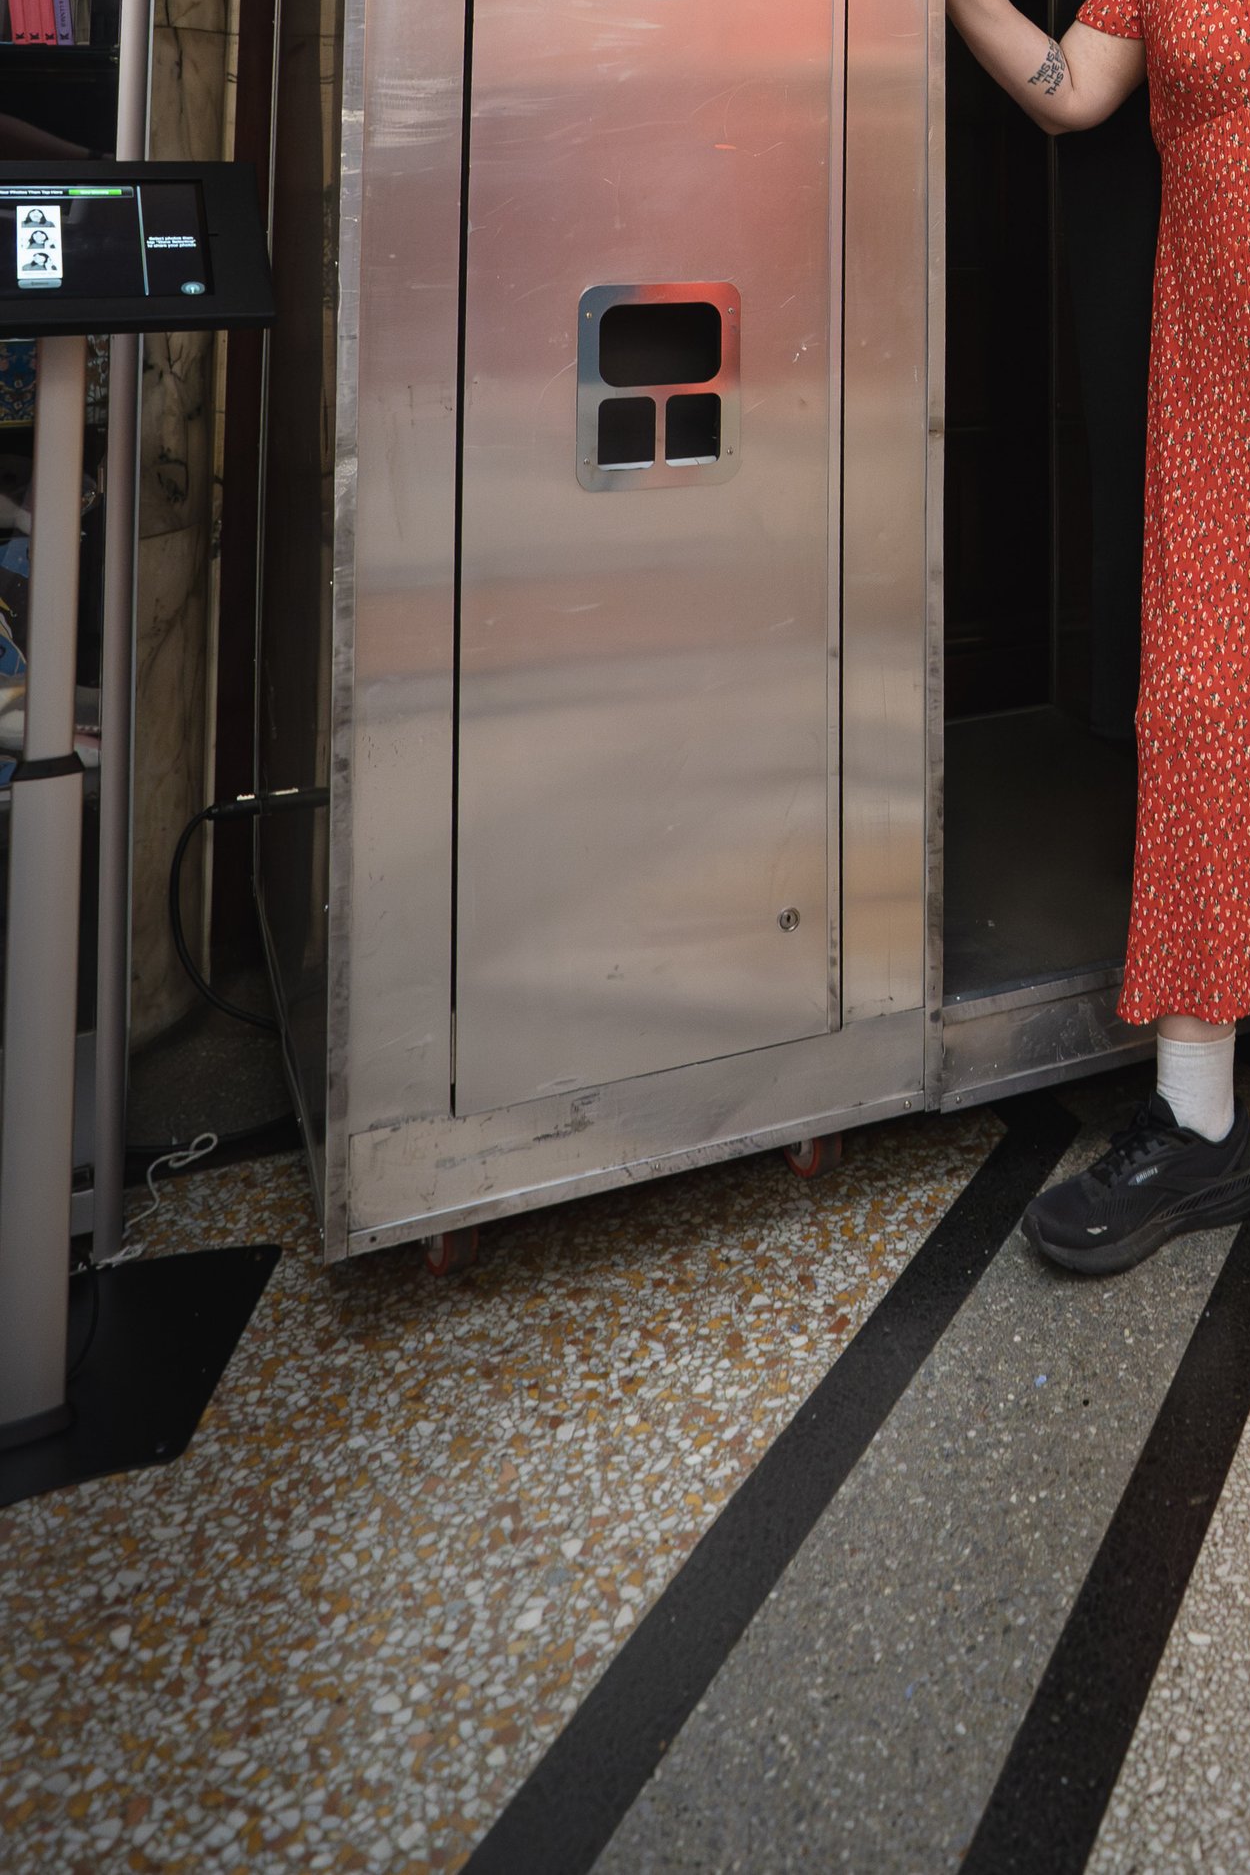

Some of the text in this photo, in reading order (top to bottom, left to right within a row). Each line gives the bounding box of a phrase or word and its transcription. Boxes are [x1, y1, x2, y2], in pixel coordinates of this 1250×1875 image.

[1027, 62, 1051, 85] THIS
[1046, 51, 1055, 62] IS
[1042, 62, 1060, 84] THE
[1045, 72, 1064, 95] THIS
